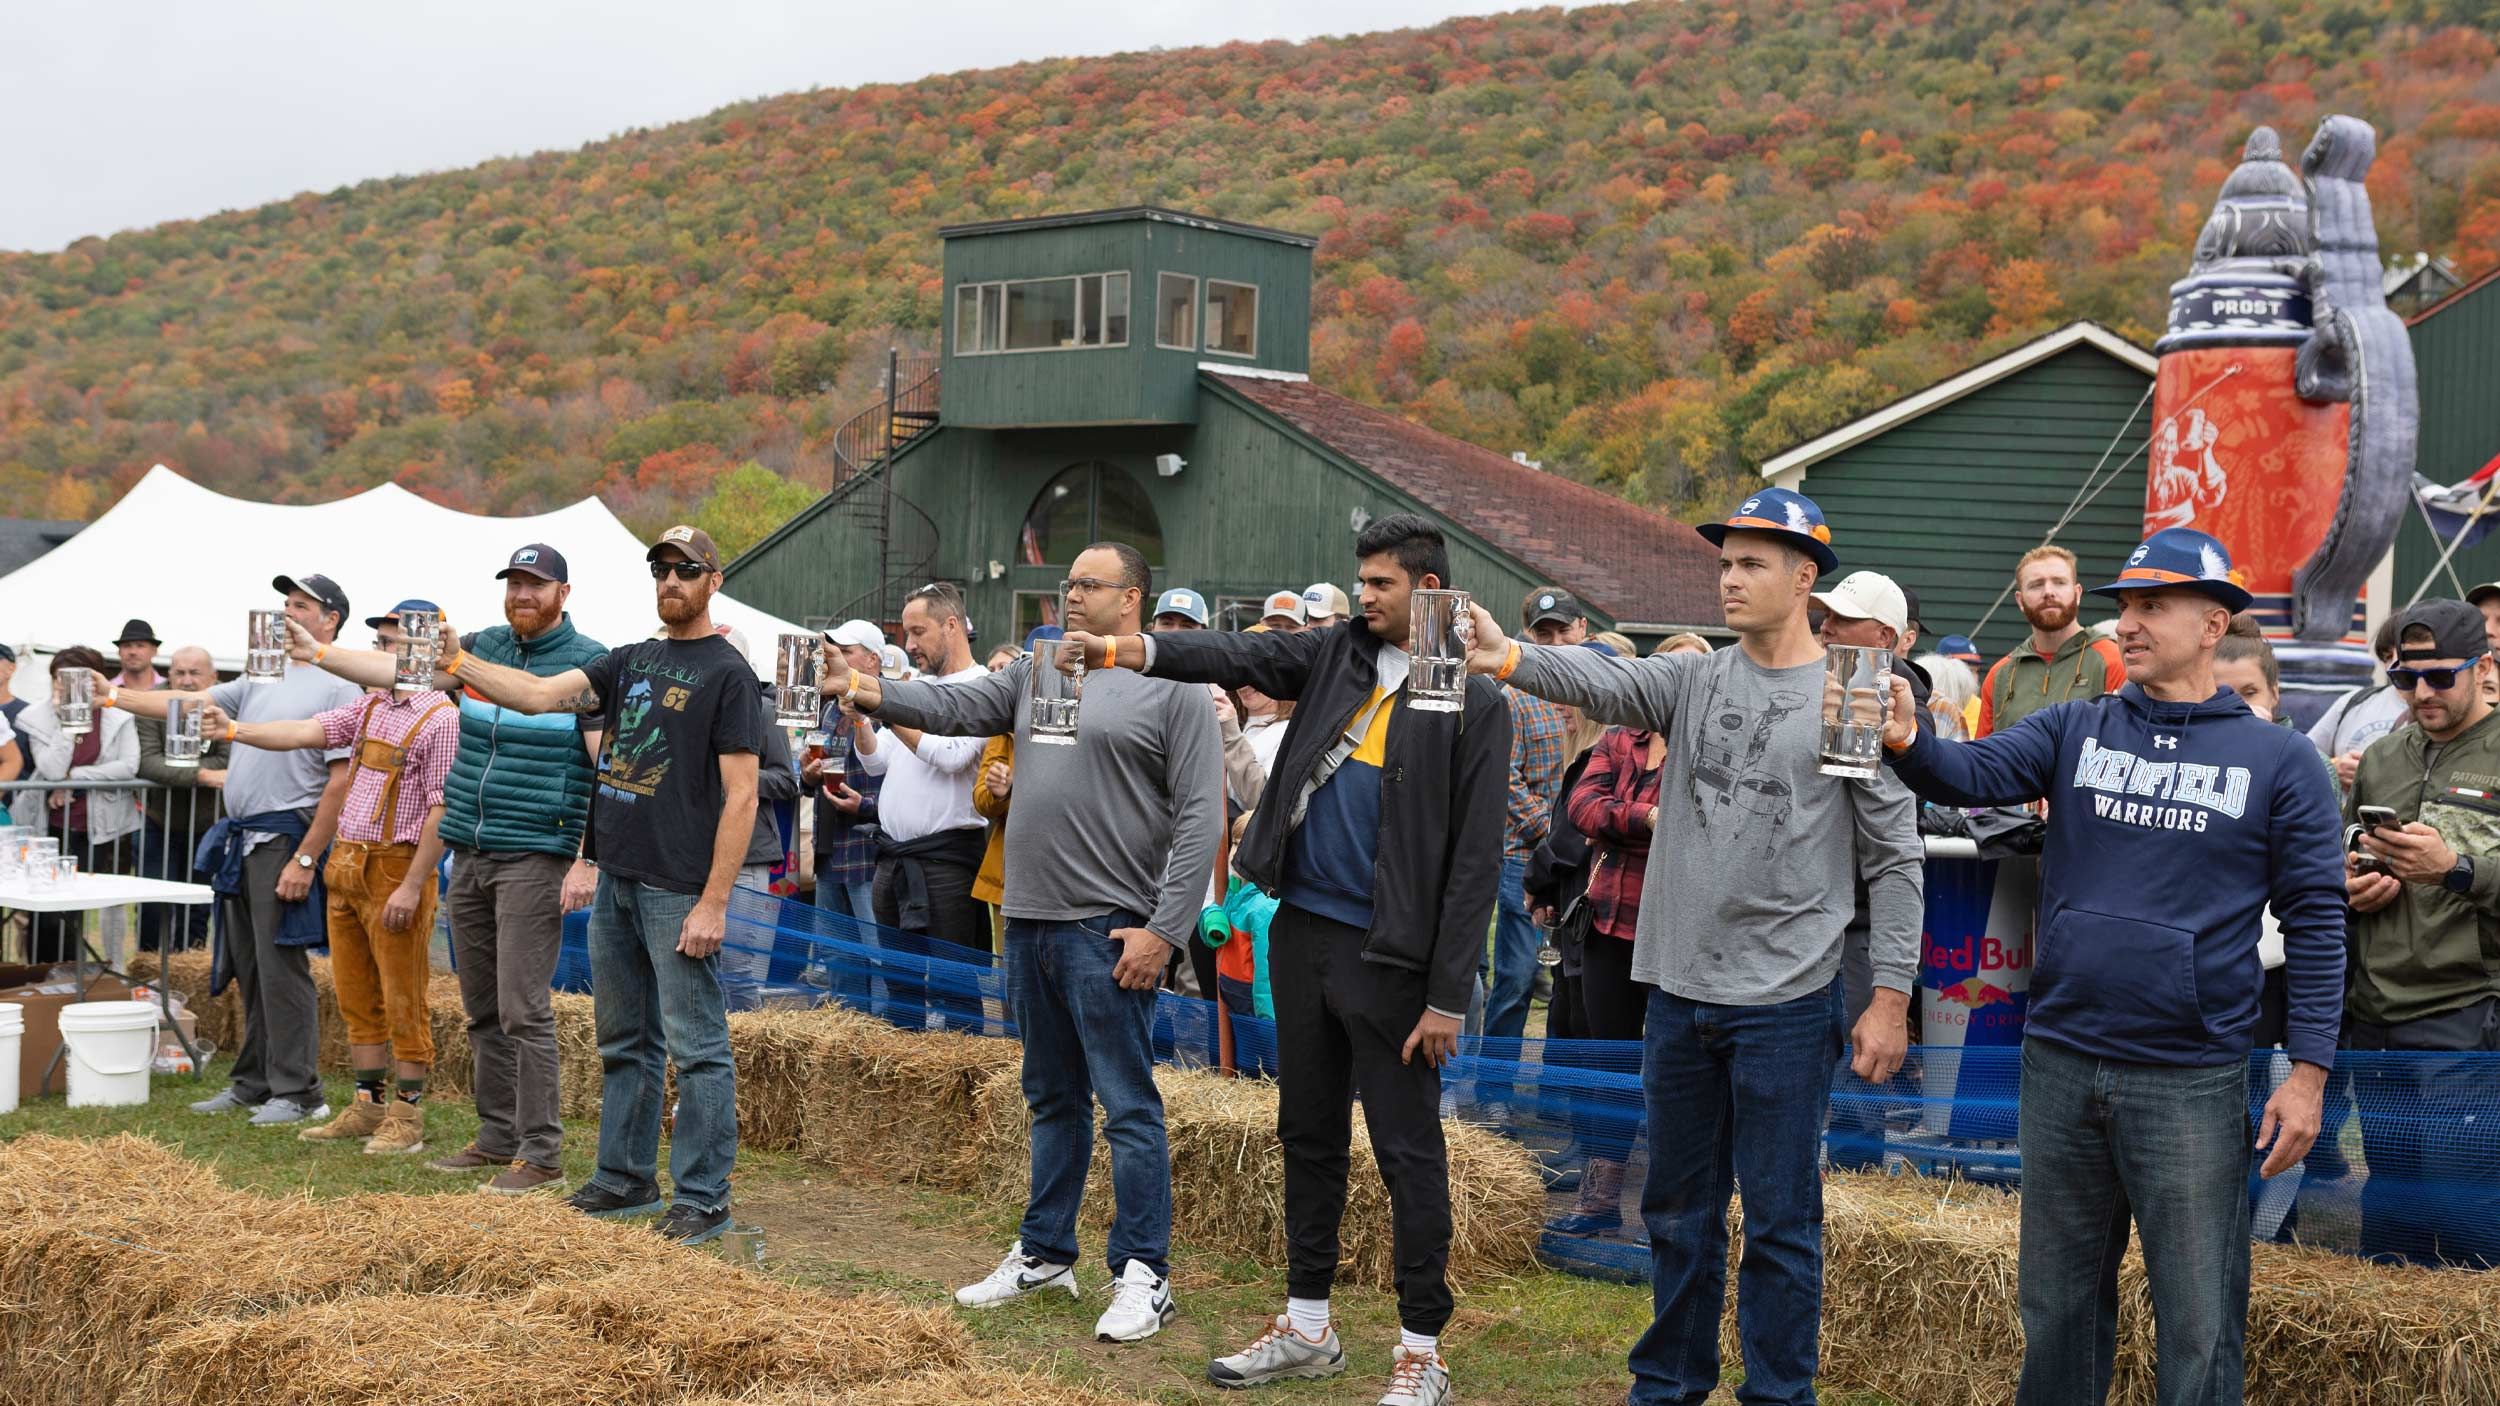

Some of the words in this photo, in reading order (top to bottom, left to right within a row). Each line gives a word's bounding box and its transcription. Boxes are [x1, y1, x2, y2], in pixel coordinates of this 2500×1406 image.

[2211, 299, 2283, 316] PROST
[2073, 736, 2251, 820] MEDFIELD
[2094, 793, 2209, 833] WARRIORS
[1921, 931, 1973, 971] Red
